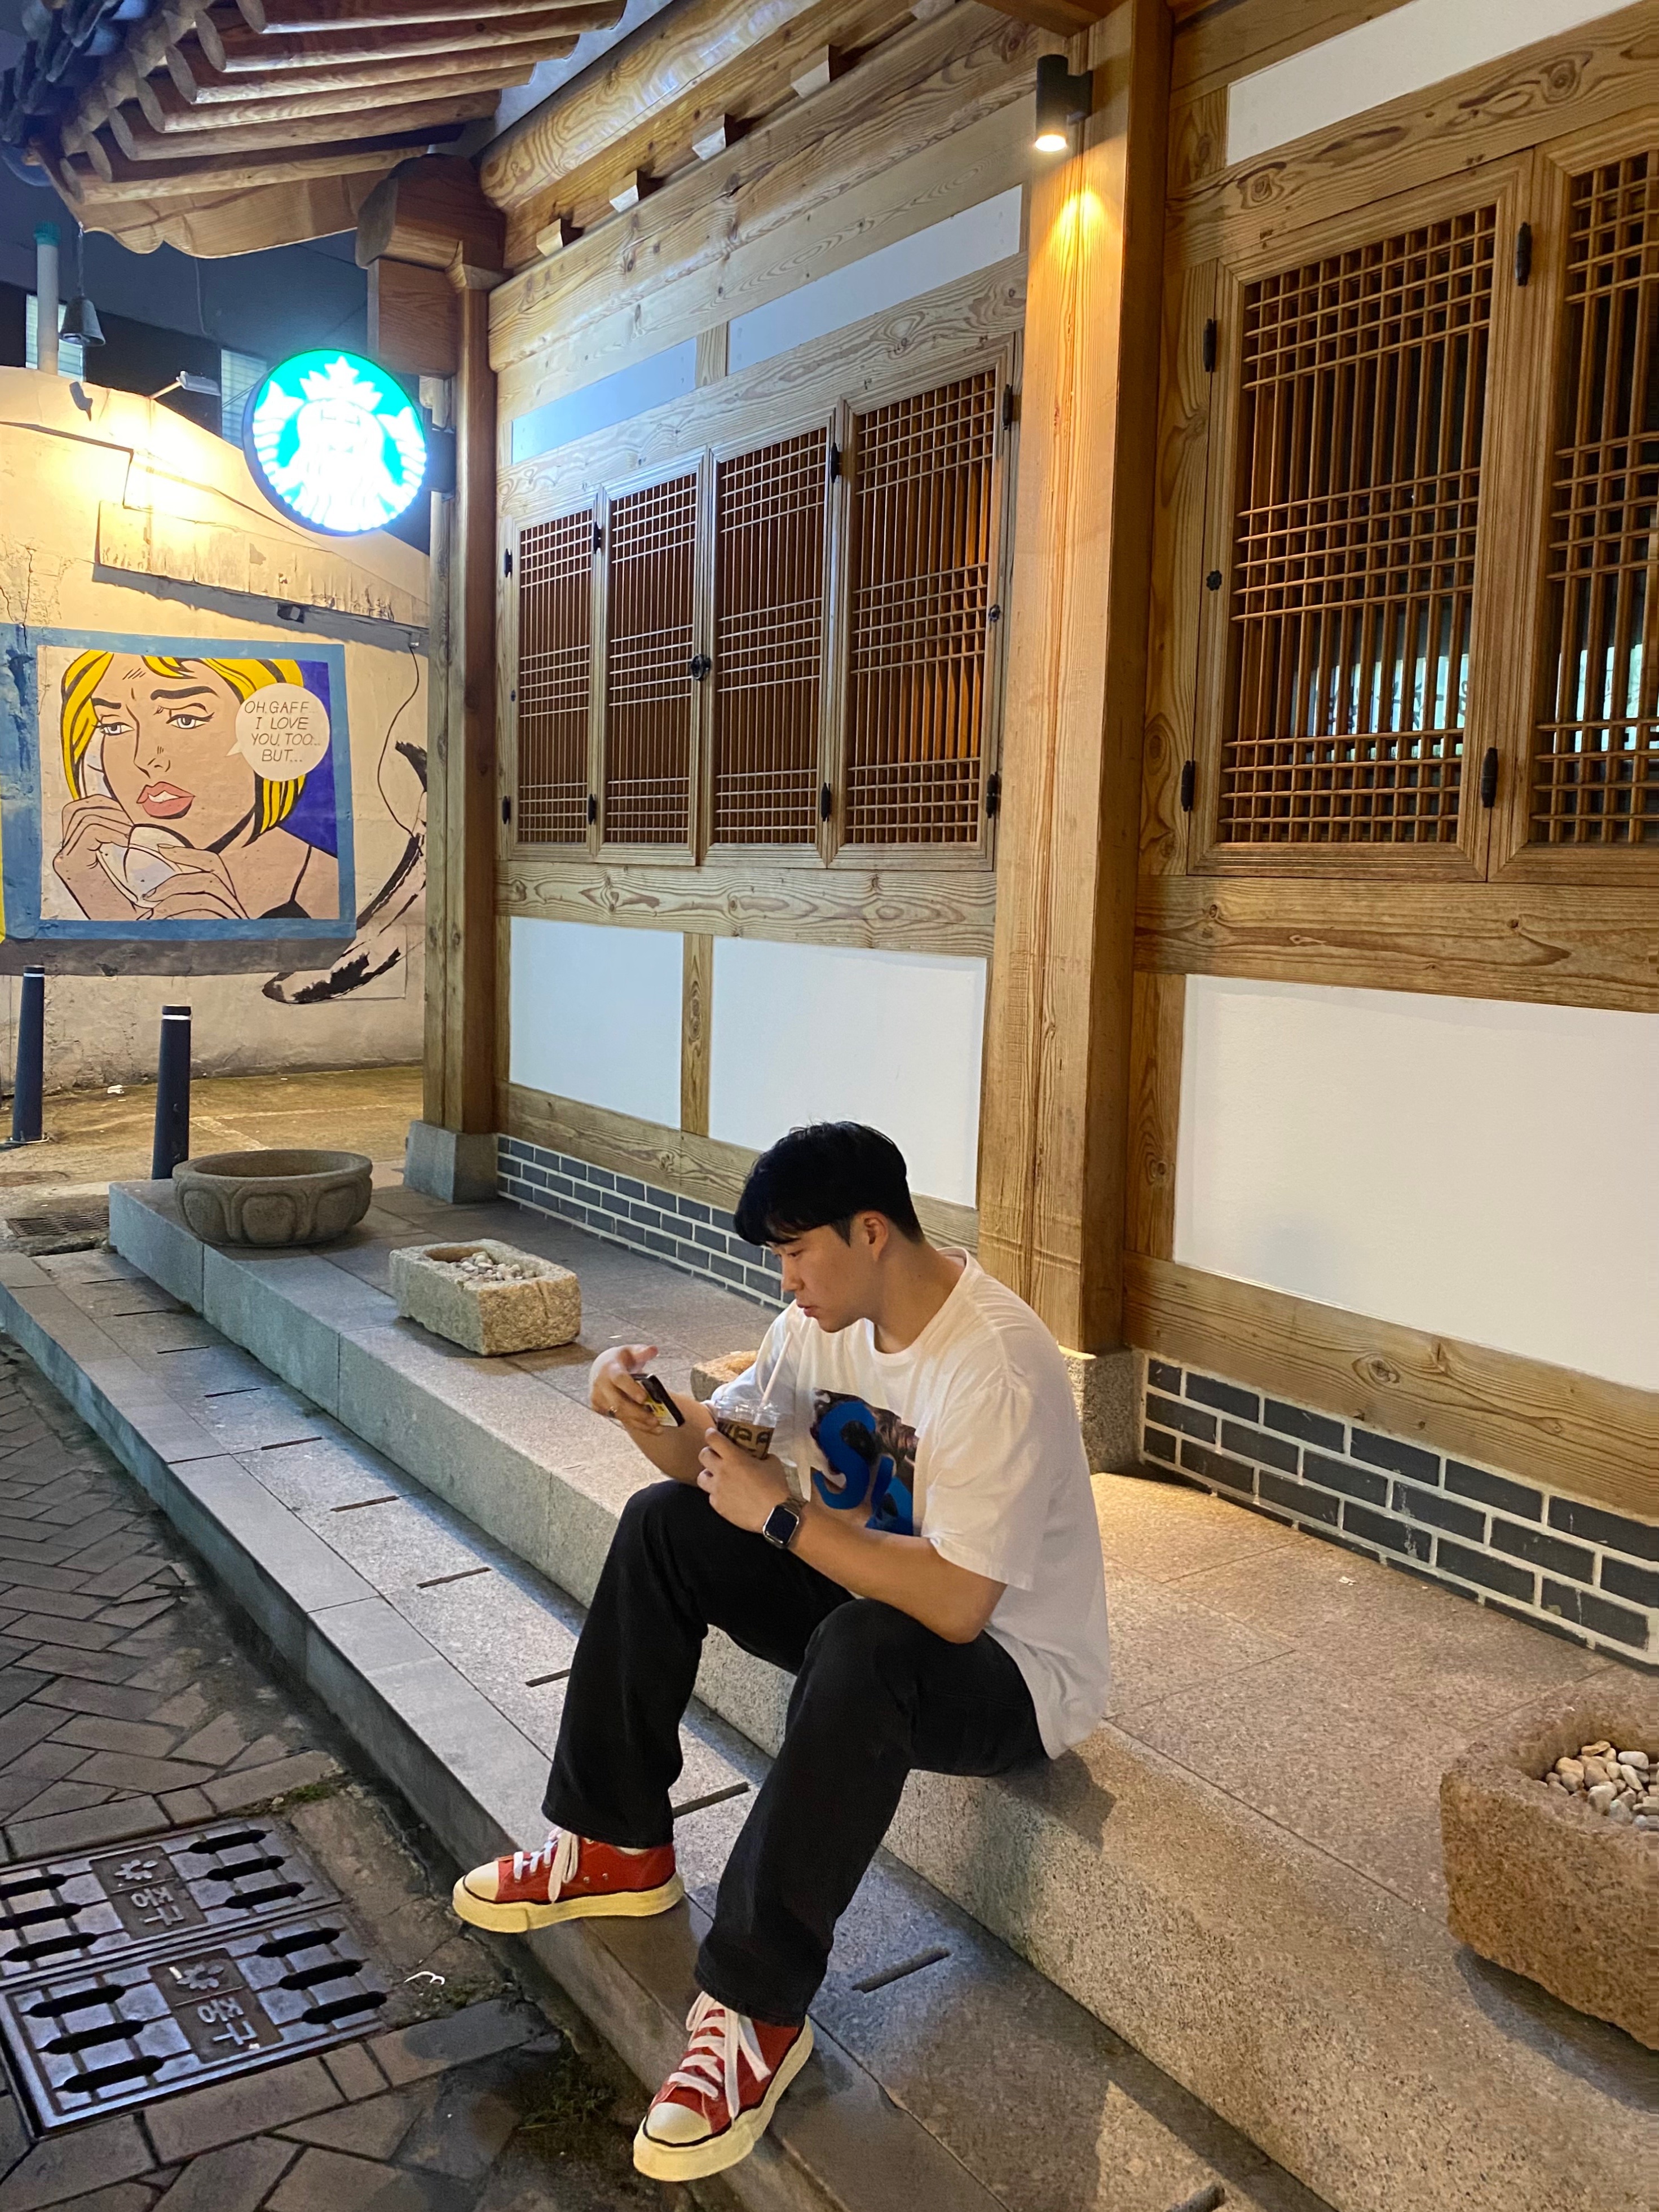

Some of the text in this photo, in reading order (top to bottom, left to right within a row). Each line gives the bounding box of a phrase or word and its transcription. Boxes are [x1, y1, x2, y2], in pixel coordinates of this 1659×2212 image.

[255, 717, 309, 730] I LOVE
[262, 749, 303, 762] BUT...
[130, 1886, 184, 1926] 중구
[197, 1997, 258, 2046] 중구
